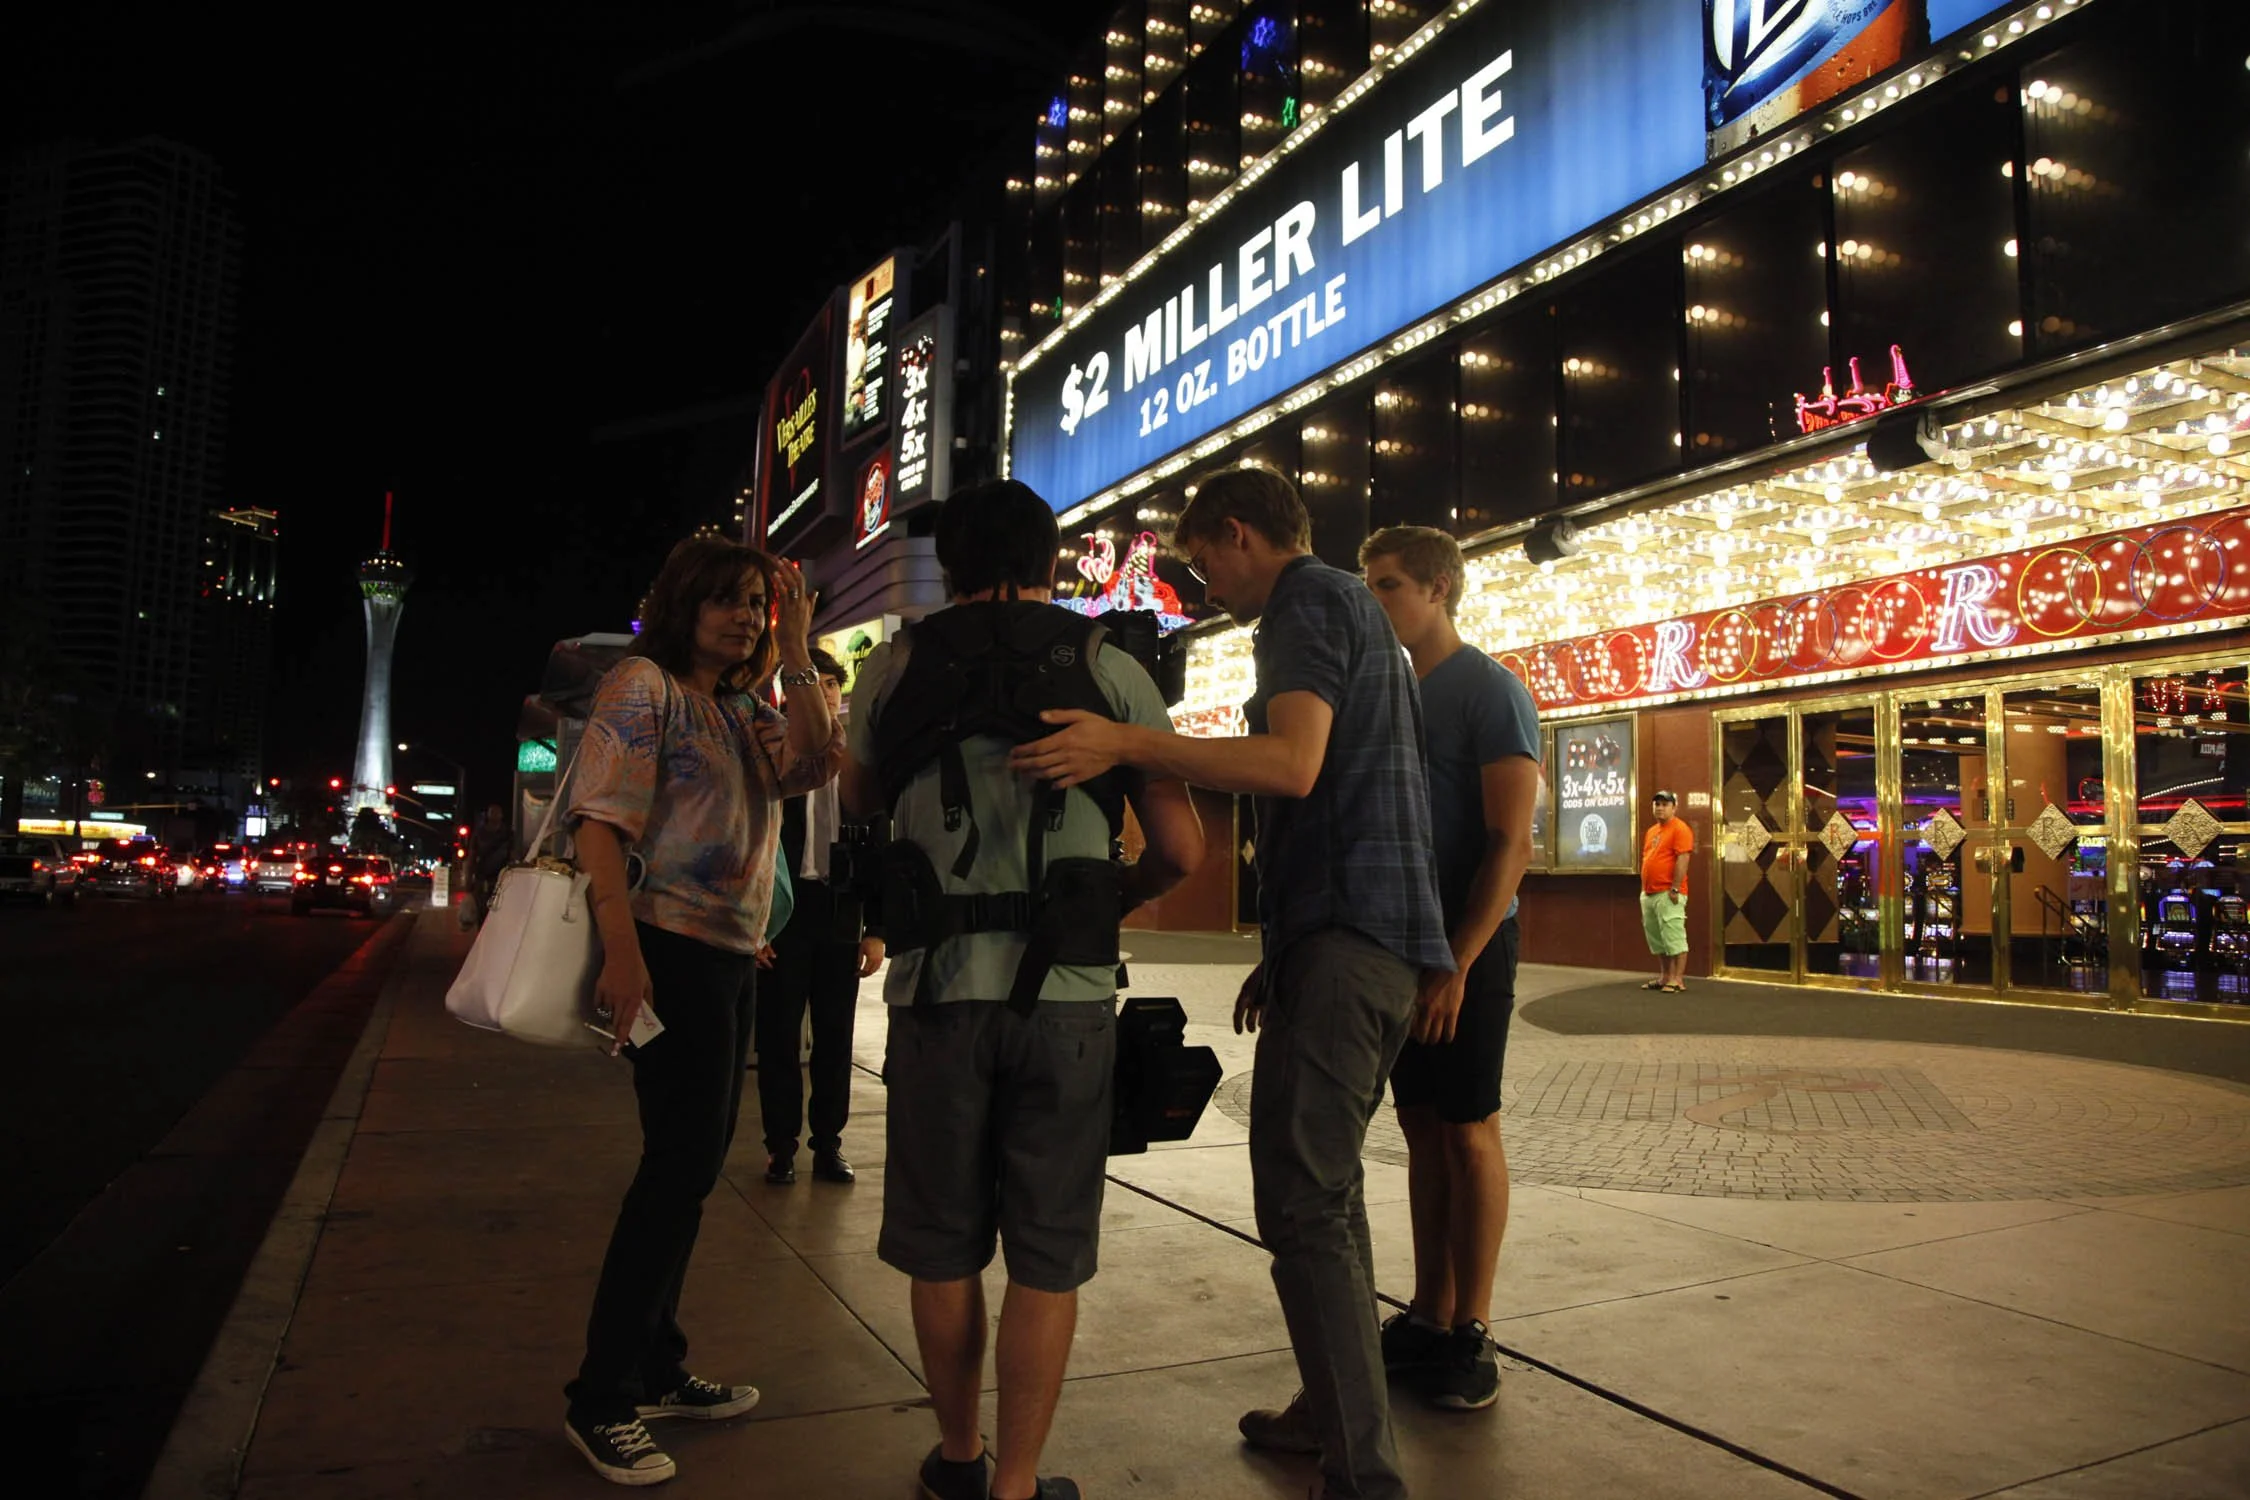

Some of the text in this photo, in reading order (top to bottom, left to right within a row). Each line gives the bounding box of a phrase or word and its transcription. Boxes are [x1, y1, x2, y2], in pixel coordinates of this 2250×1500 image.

[1060, 49, 1515, 436] $2 MILLER LITE
[1139, 272, 1346, 437] 12 OZ. BOTTLE
[1931, 564, 2018, 652] R
[1648, 620, 1708, 692] R
[1563, 796, 1625, 809] ODDS ON CRAPS
